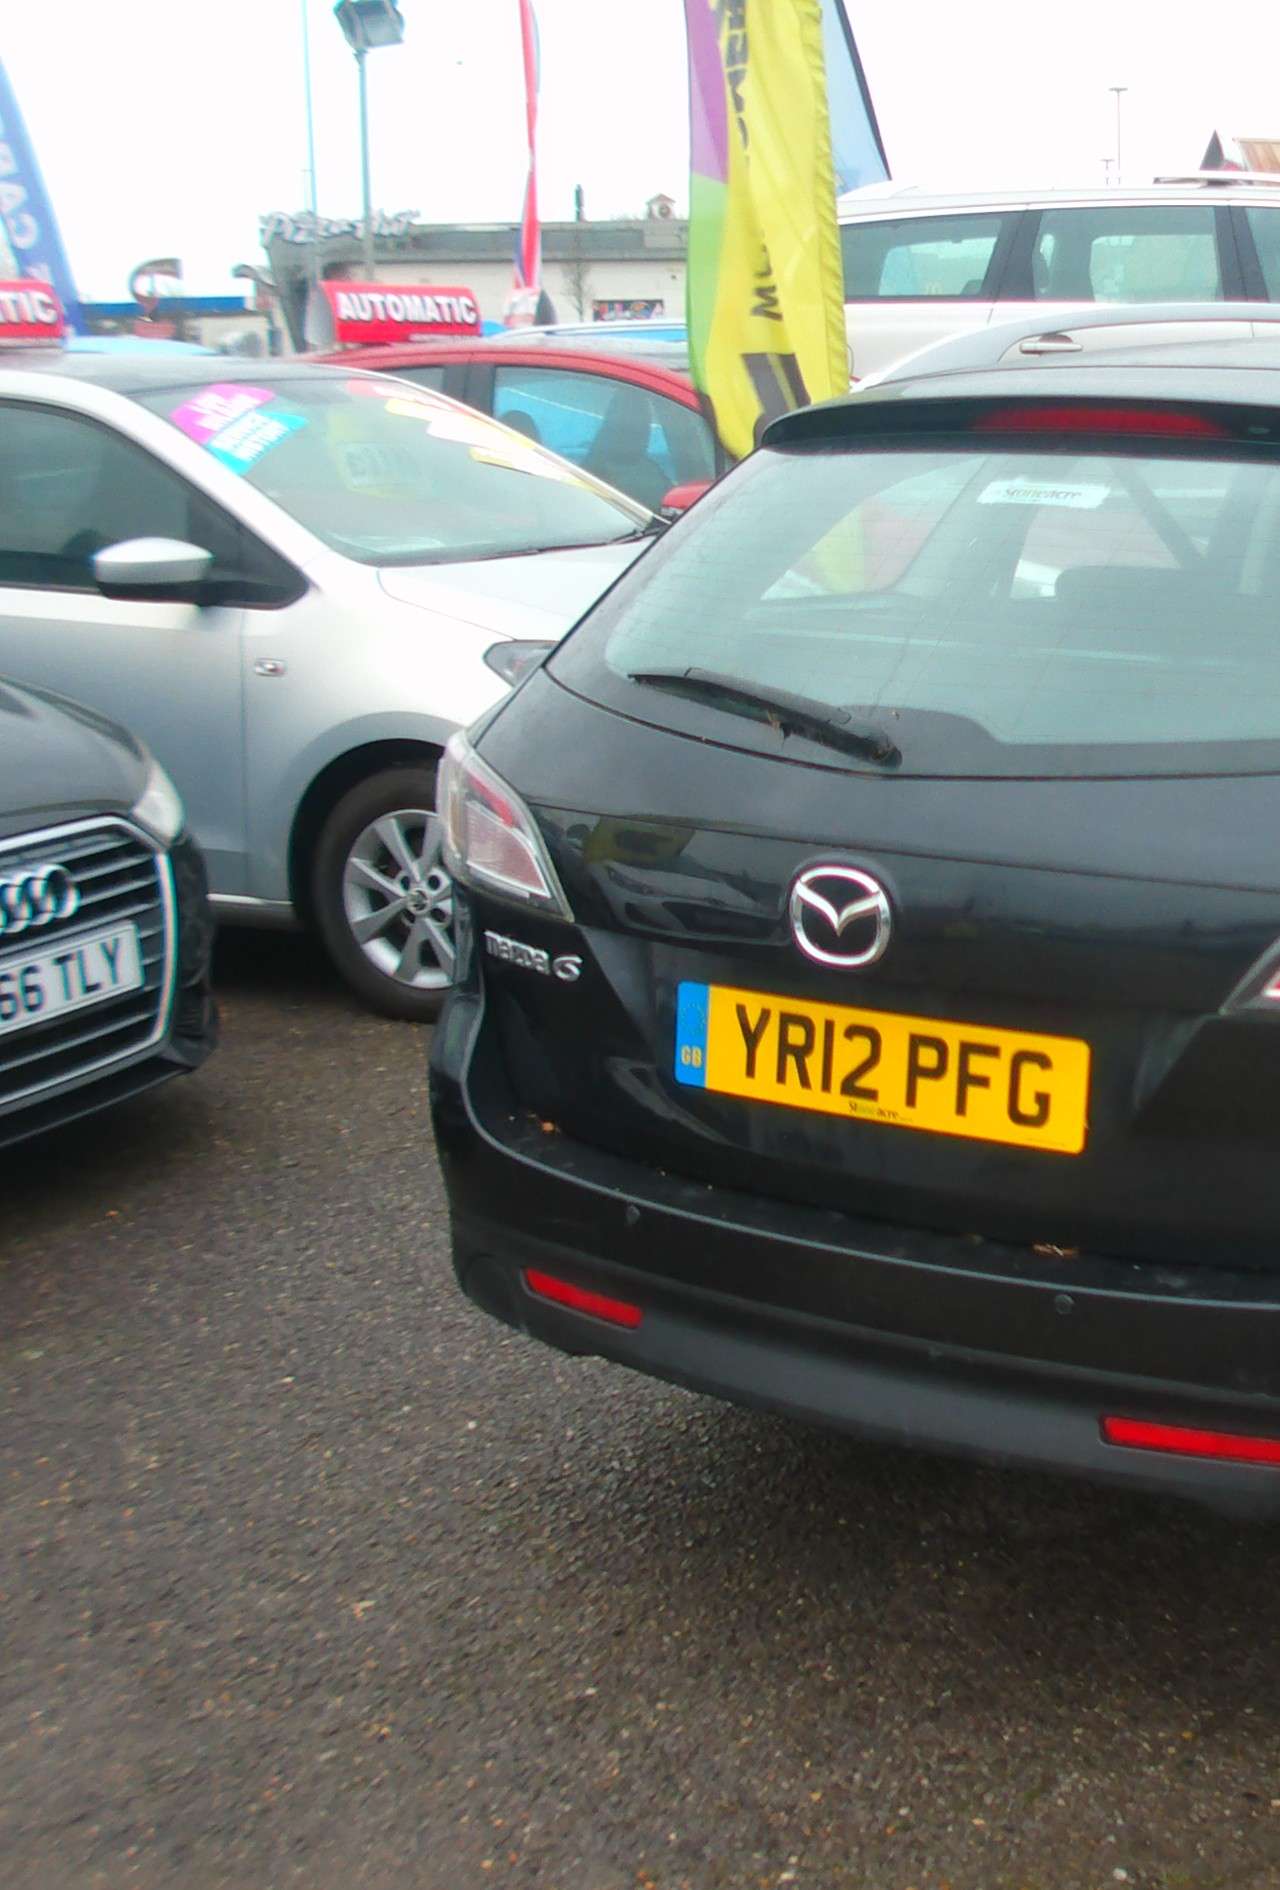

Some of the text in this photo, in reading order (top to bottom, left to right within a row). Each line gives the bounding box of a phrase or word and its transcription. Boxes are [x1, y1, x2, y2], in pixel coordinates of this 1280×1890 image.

[335, 291, 478, 324] AUTOMATIC
[53, 937, 120, 1001] TLY
[681, 1045, 702, 1068] GB
[735, 1003, 1053, 1128] YR12 PFG
